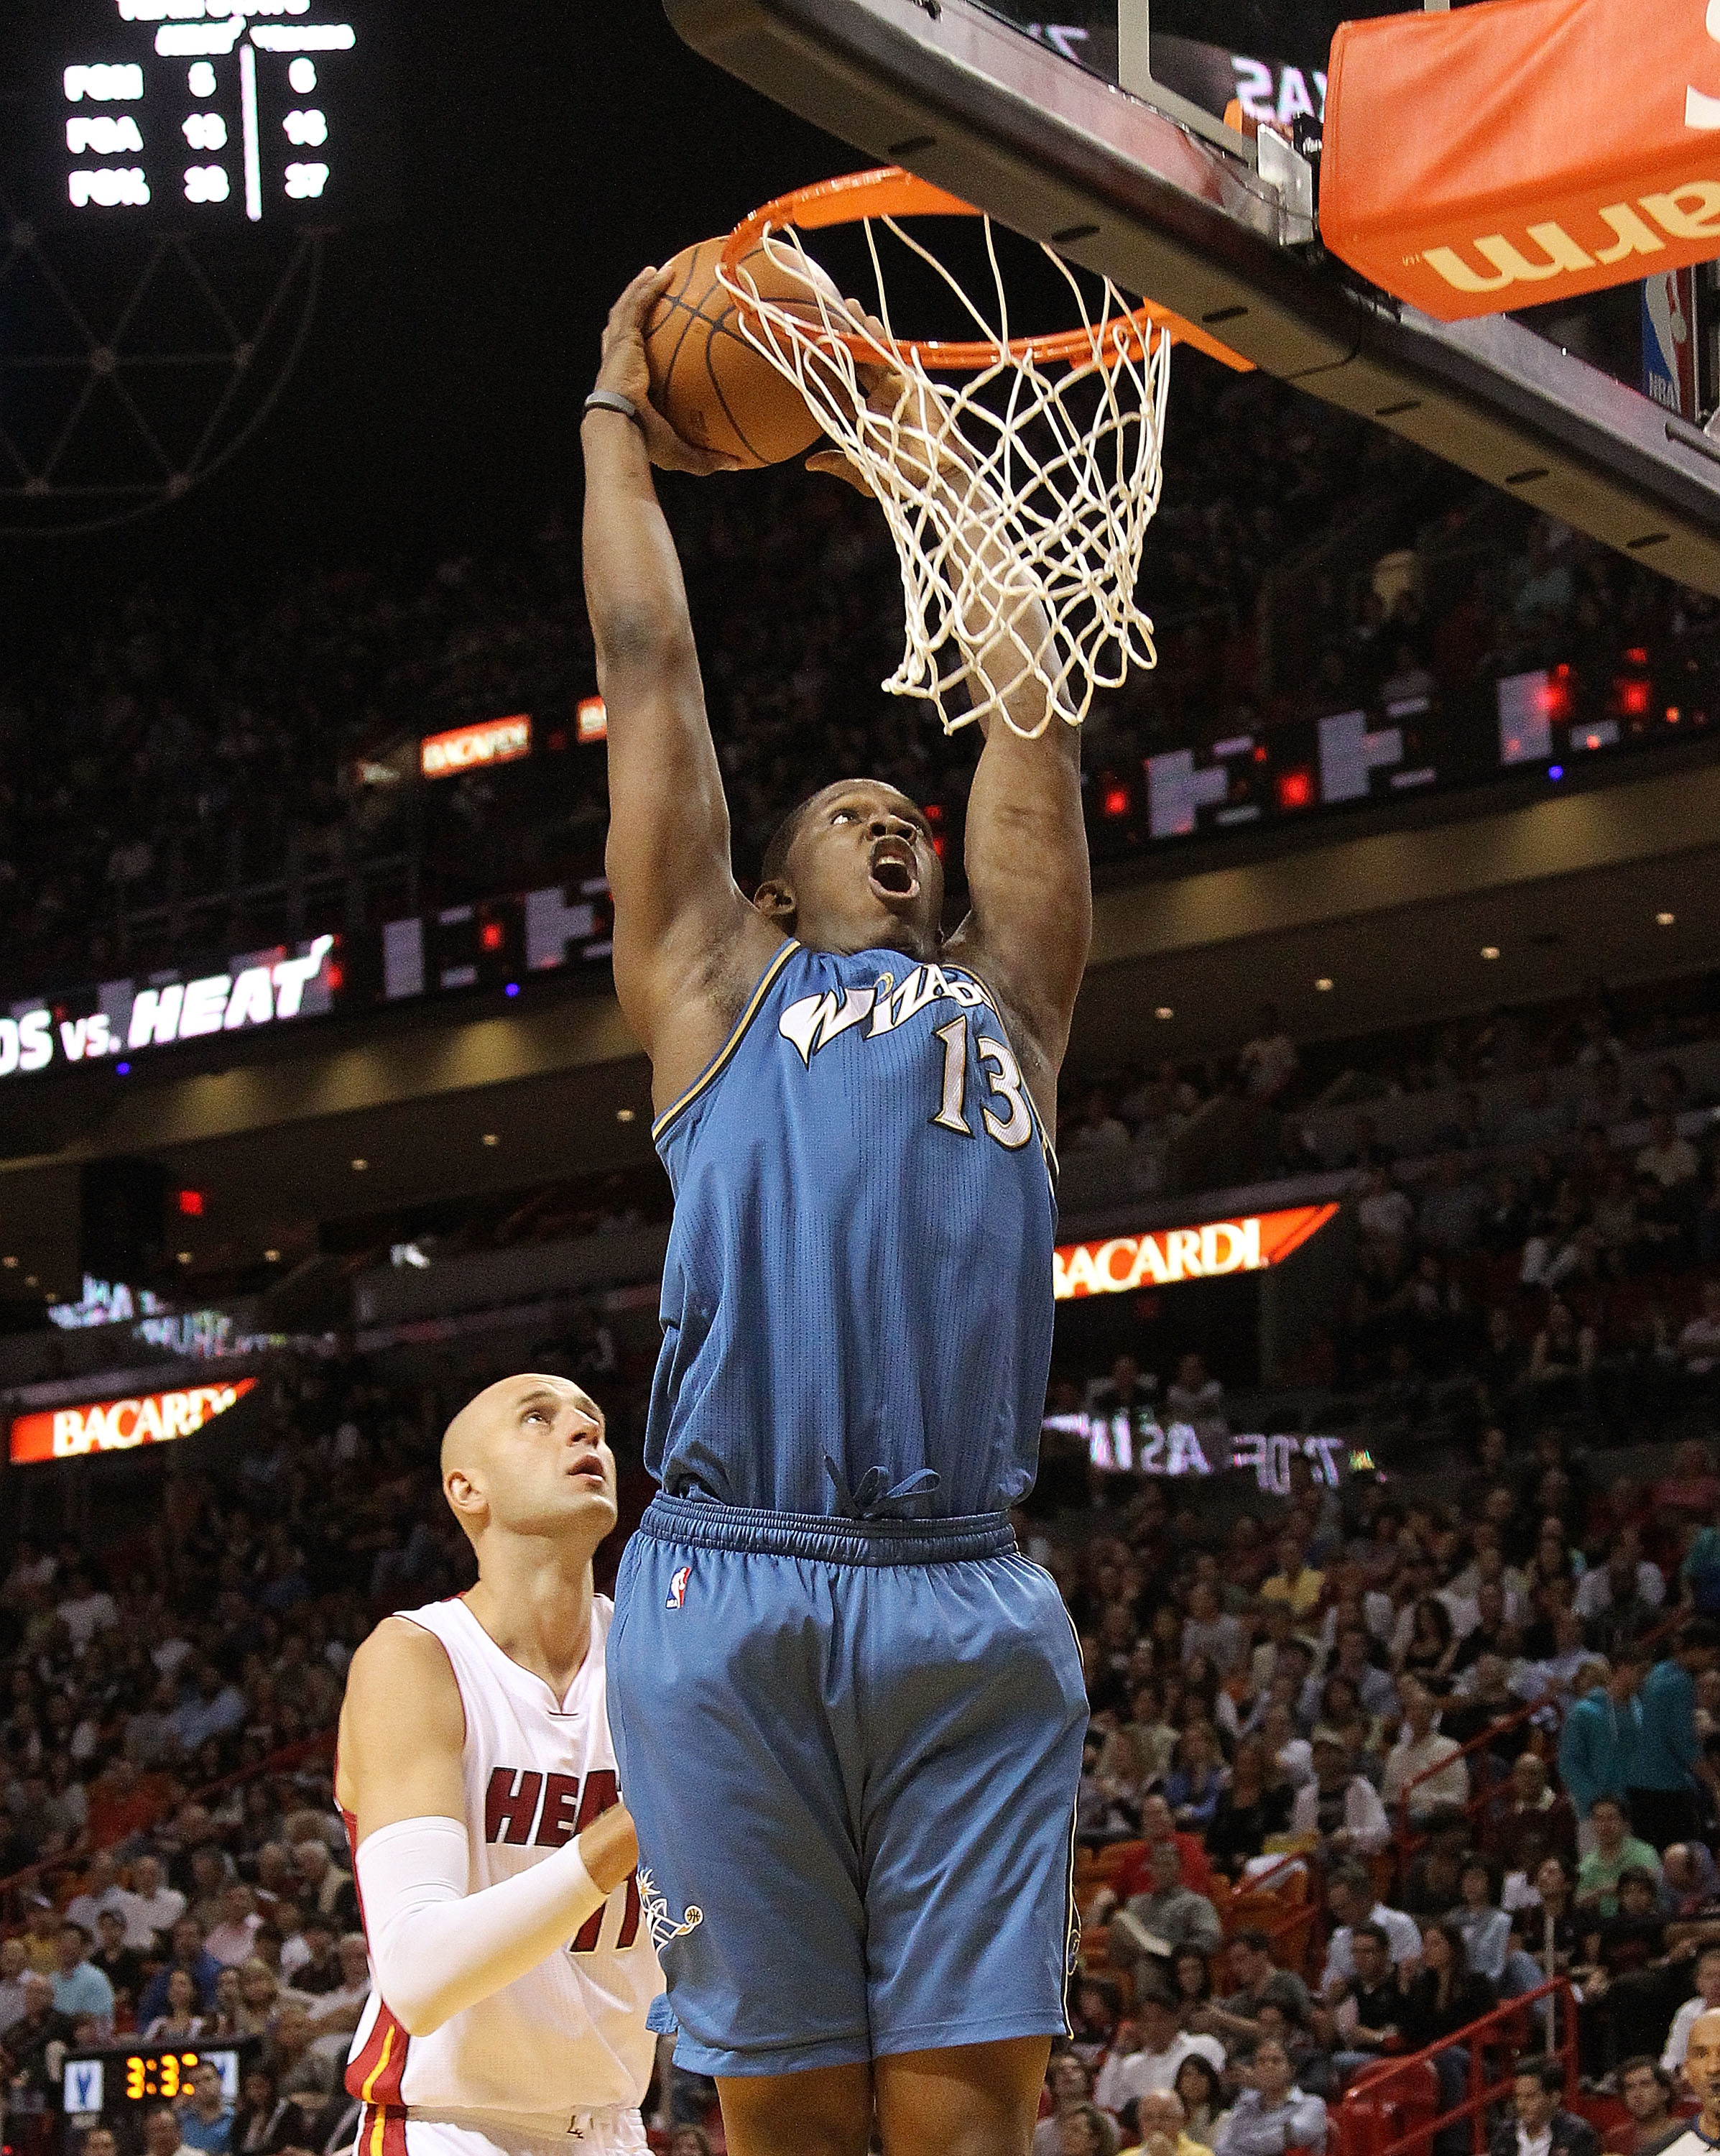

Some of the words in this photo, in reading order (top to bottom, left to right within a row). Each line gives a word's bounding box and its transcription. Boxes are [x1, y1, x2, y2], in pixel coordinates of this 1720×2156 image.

[128, 934, 333, 1048] HEAT
[930, 1014, 1032, 1150] 13
[484, 1766, 623, 1848] HEA
